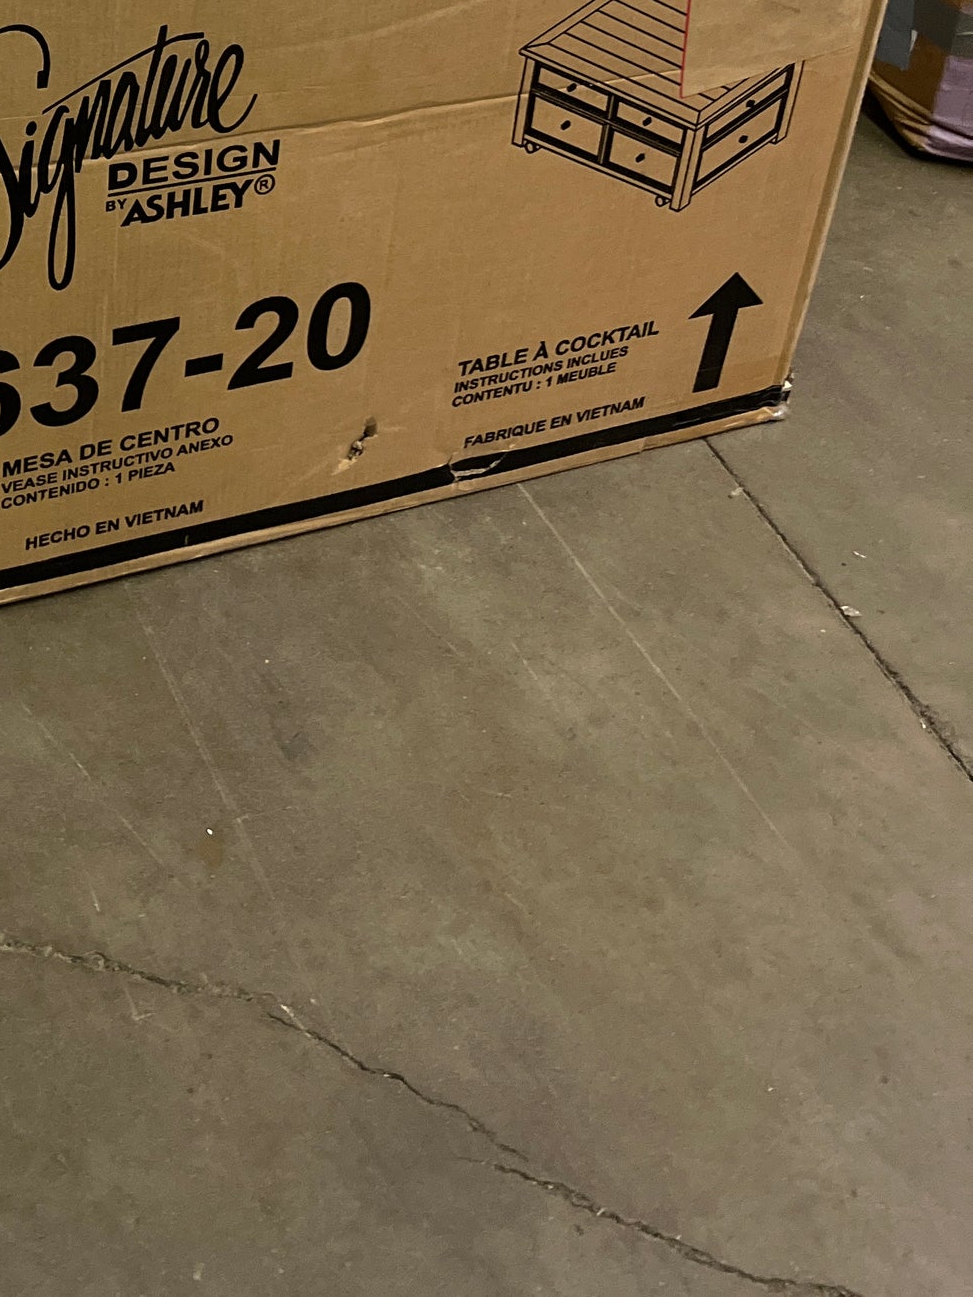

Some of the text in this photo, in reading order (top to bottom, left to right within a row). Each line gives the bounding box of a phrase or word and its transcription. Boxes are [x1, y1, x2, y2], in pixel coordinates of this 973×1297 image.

[108, 139, 281, 191] DESIGN
[105, 198, 127, 212] BY
[453, 345, 629, 393] INSTRUCTIONS INCLUES
[458, 320, 660, 376] TABLE À COCKTAIL
[451, 380, 533, 407] CONTENTU
[545, 377, 553, 388] 1
[556, 362, 617, 385] MEUBLE
[2, 417, 220, 478] MESA DE CENTRO
[463, 396, 646, 449] FABRIQUE EN VIETNAM
[0, 434, 234, 494] VEASE INSTRUCTIVO ANEXO
[0, 478, 100, 509] CONTENIDO
[115, 473, 123, 484] 1
[128, 462, 176, 481] PIEZA
[25, 500, 205, 550] HECHO EN VIETNAM
